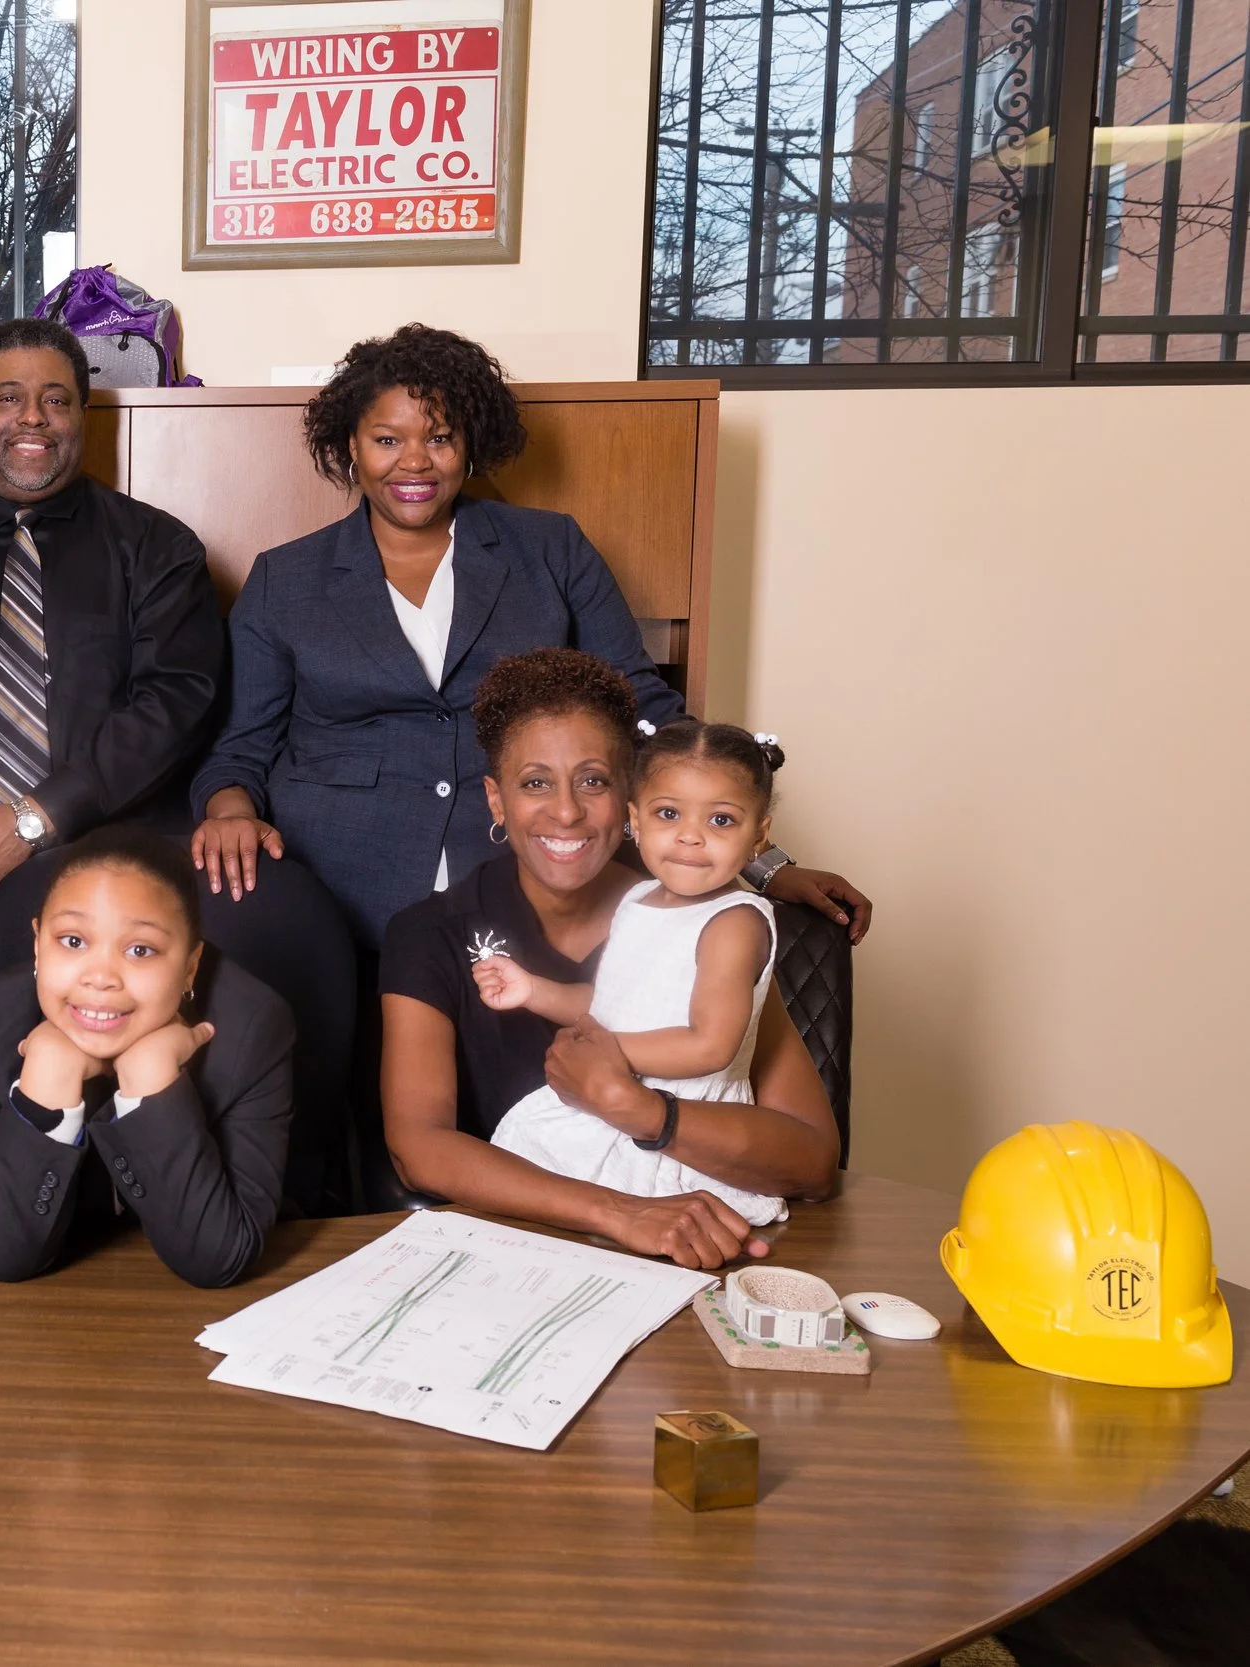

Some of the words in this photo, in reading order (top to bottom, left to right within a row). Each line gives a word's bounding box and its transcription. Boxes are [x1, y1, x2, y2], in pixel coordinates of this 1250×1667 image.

[251, 35, 394, 77] WIRING
[417, 32, 465, 69] BY
[245, 85, 467, 151] TAYLOR
[229, 154, 396, 191] ELECTRIC
[416, 151, 479, 182] CO.
[223, 205, 275, 237] 312
[1087, 1260, 1109, 1281] TAYLOR
[1110, 1258, 1147, 1271] ELECTRIC
[1101, 1269, 1142, 1310] TEC
